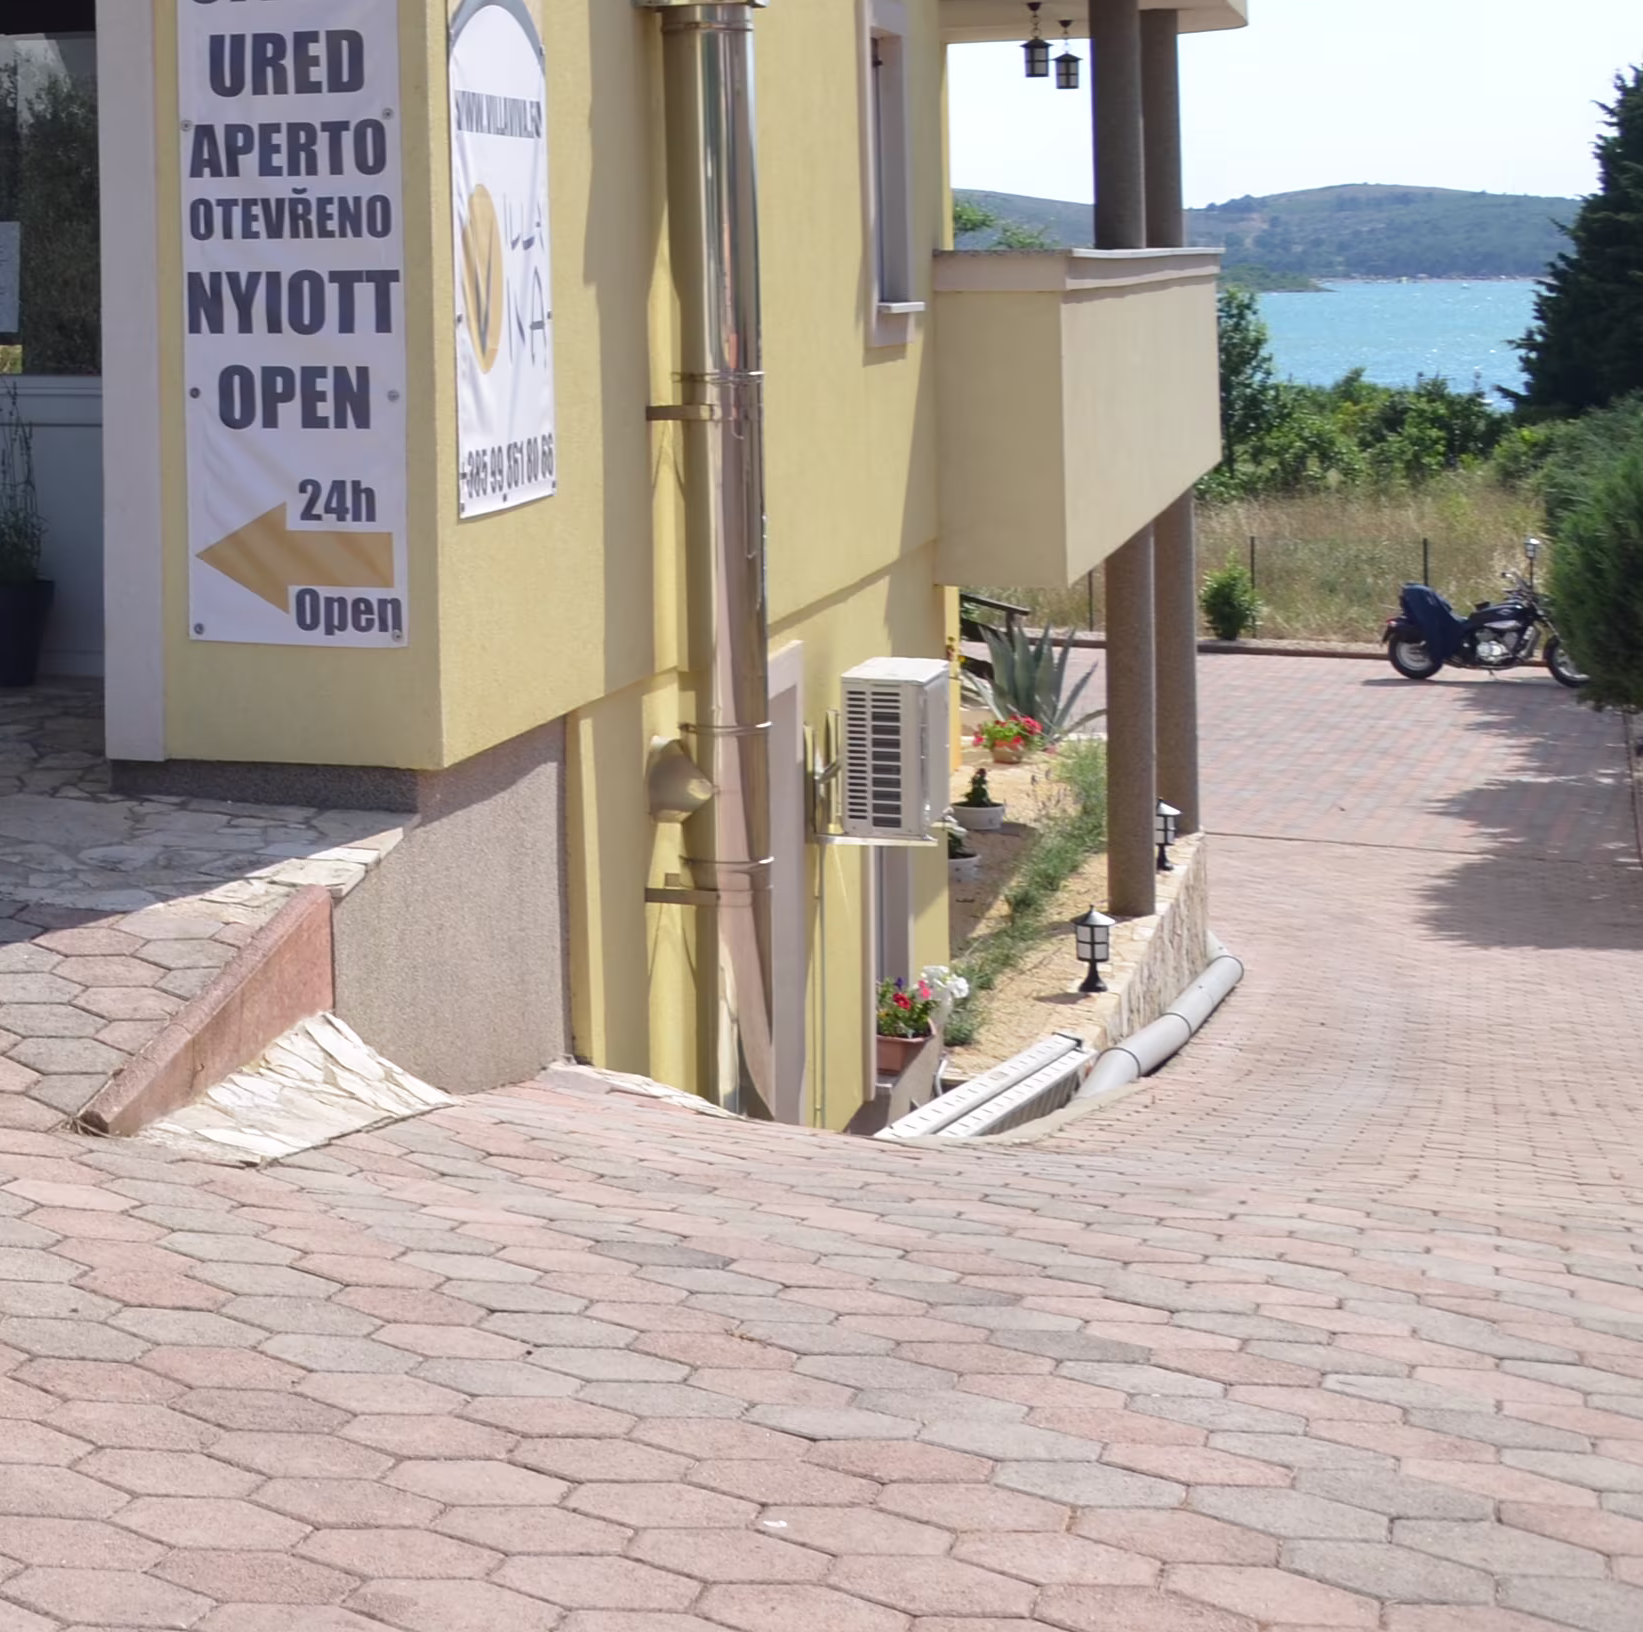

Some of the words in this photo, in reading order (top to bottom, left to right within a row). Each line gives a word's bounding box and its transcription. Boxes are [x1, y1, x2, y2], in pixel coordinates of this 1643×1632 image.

[209, 30, 364, 97] URED
[190, 119, 386, 178] APERTO
[190, 188, 391, 240] OTEVŘENO
[188, 270, 399, 335] NYIOTT
[219, 365, 370, 429] OPEN
[490, 445, 504, 494] 99
[526, 436, 539, 484] 80
[541, 432, 555, 480] 66
[299, 479, 375, 522] 24h
[296, 588, 402, 635] Open
